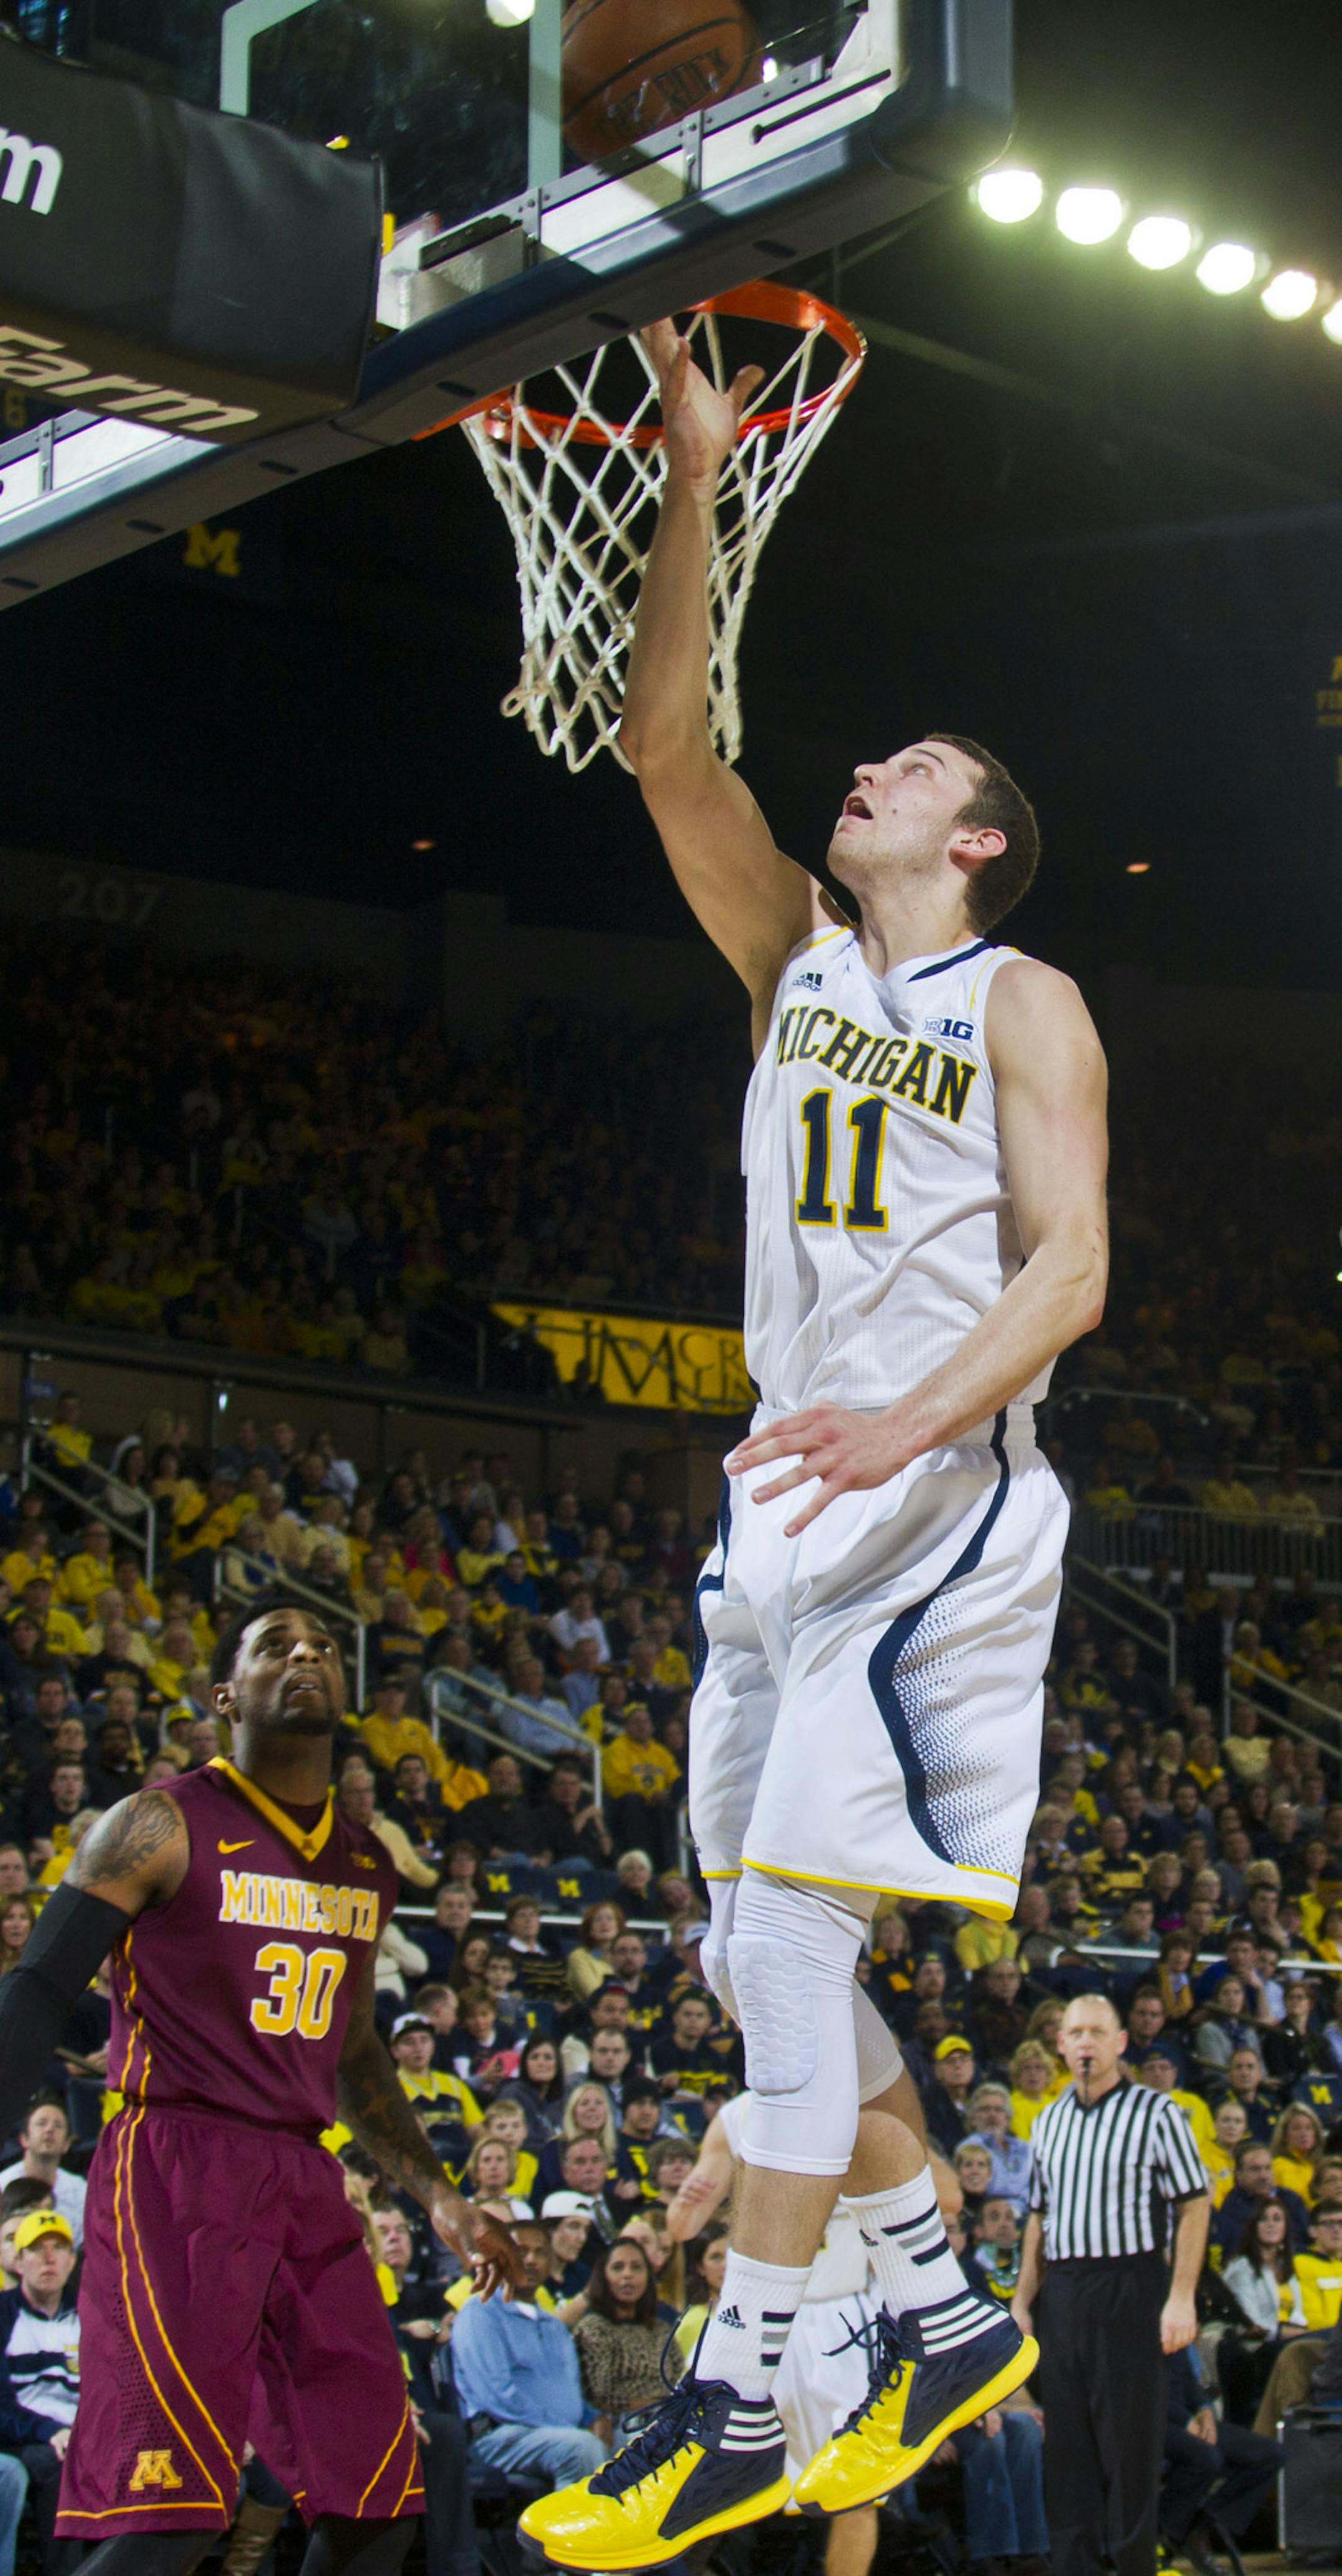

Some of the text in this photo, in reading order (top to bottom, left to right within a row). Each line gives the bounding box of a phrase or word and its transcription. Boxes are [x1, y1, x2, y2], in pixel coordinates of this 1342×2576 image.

[795, 1087, 889, 1232] 11
[219, 1870, 379, 1942] MINNESOTA
[250, 1941, 347, 2040] 30
[129, 2449, 183, 2491] M
